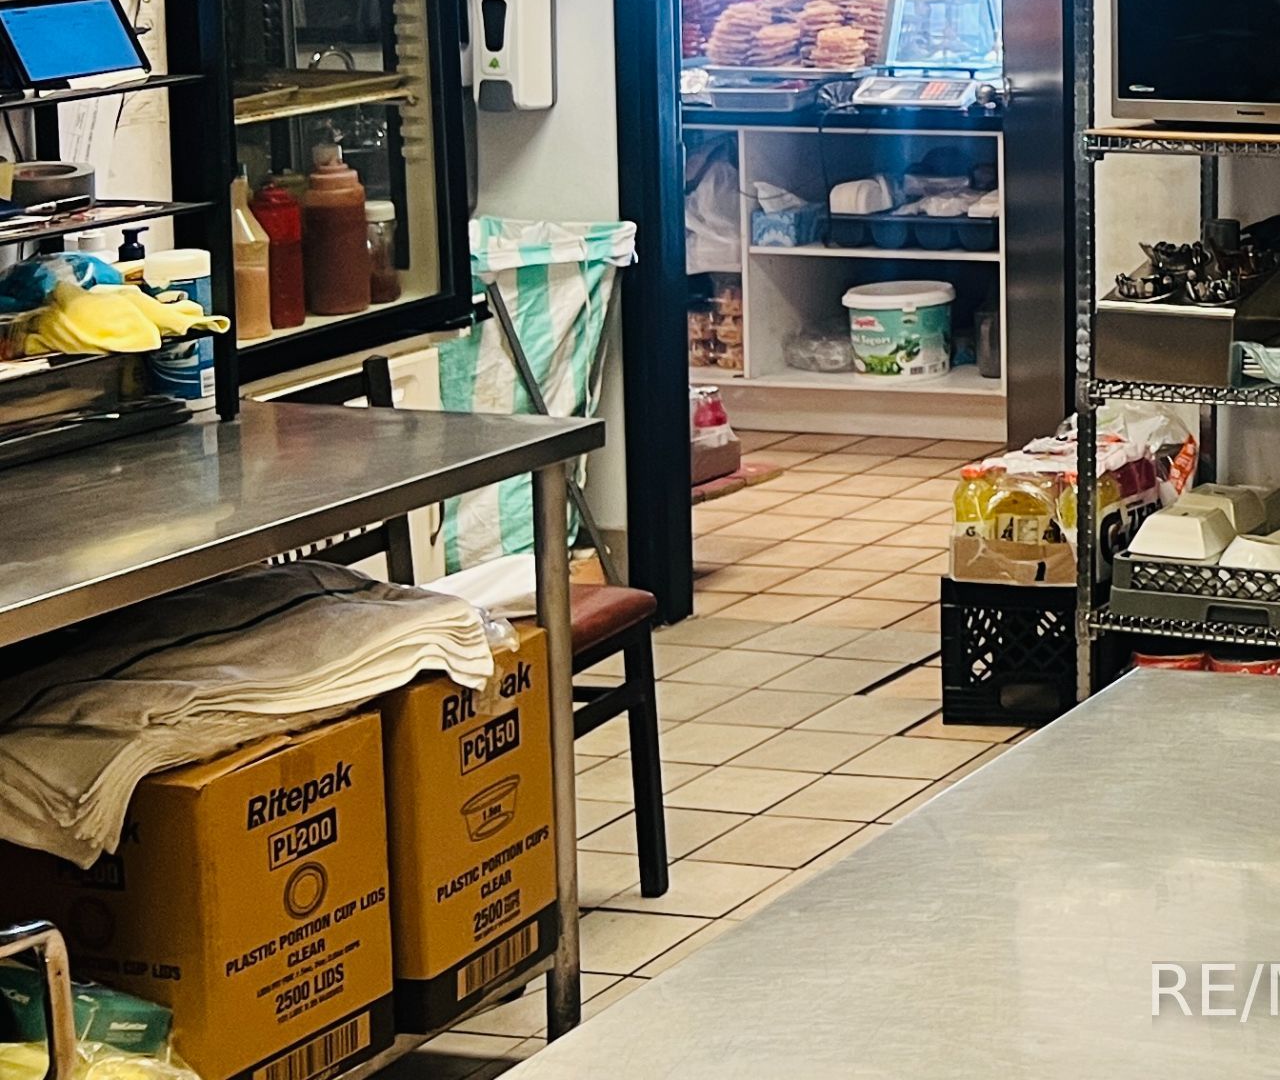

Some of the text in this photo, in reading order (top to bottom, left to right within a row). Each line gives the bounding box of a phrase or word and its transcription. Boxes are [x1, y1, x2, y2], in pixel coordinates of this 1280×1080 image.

[442, 661, 531, 732] Ritak
[463, 718, 516, 767] PC150
[247, 760, 353, 831] Ritepak
[273, 816, 333, 863] PL200
[437, 866, 480, 903] PLASTIC
[481, 840, 524, 876] PORTION
[525, 824, 549, 850] CUPS
[480, 868, 512, 900] CLEAR
[225, 886, 386, 977] PLASTIC PORTION CUP LIDS
[473, 898, 503, 934] 2500
[287, 937, 326, 968] CLEAR
[275, 962, 345, 1015] 2500 LIDS
